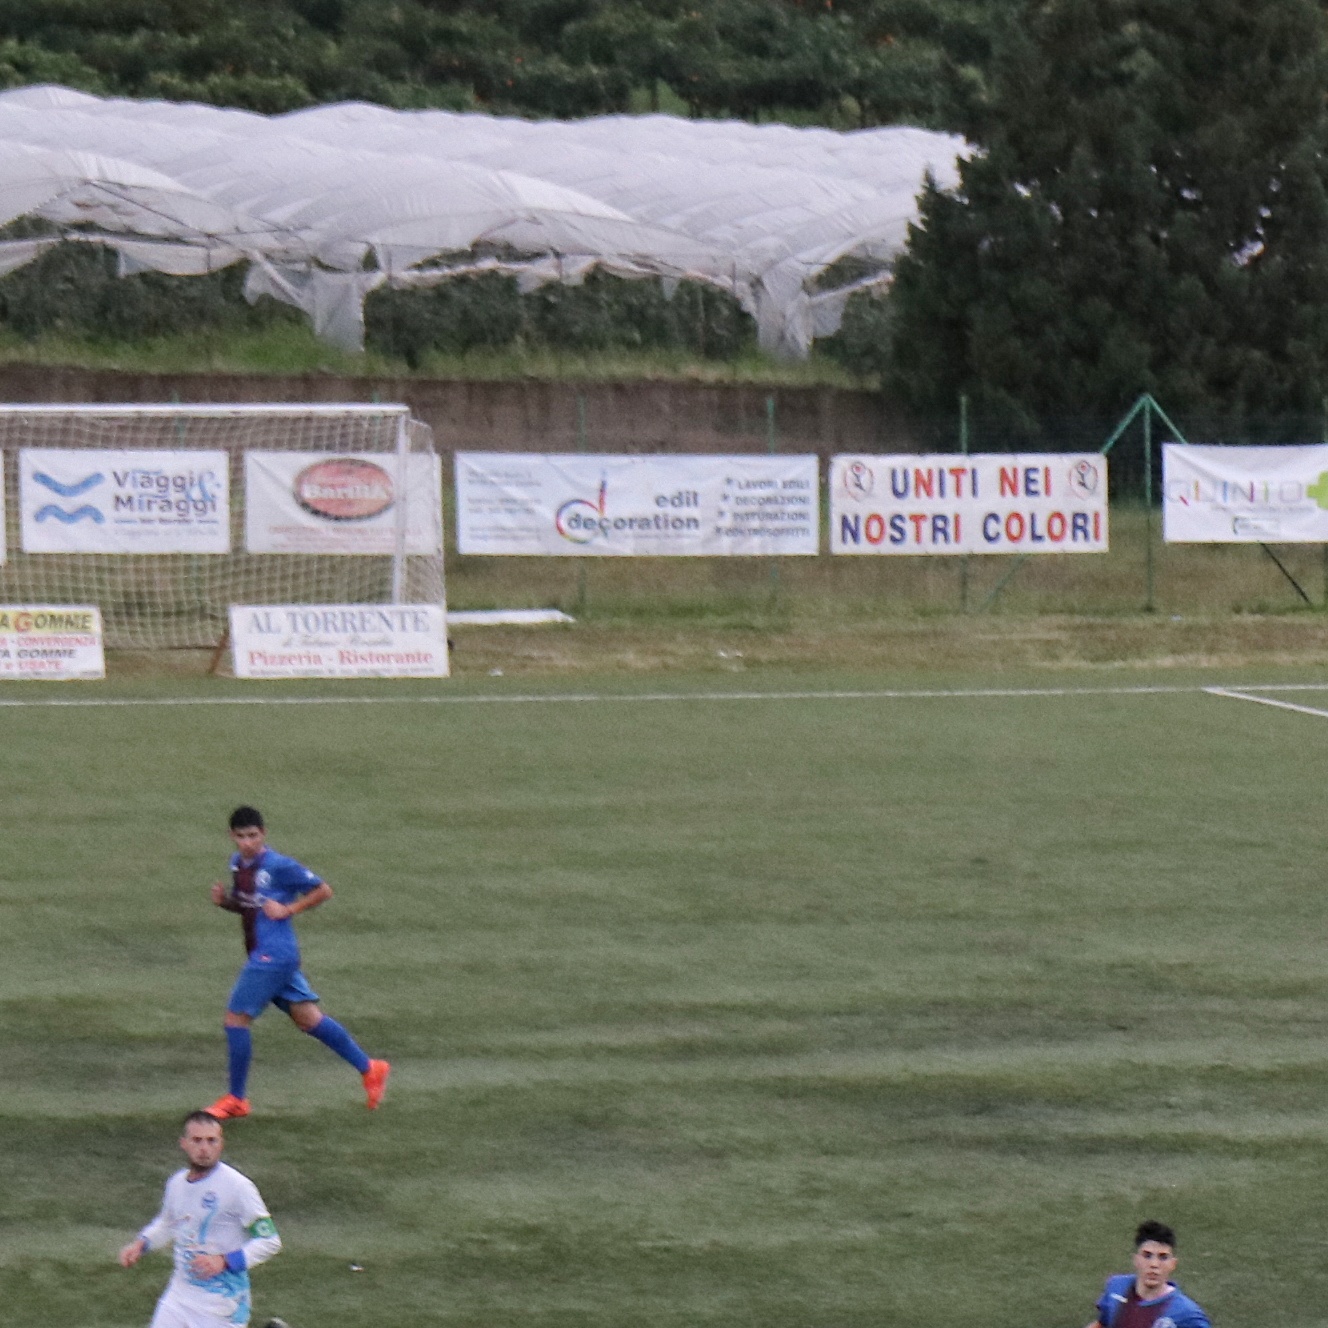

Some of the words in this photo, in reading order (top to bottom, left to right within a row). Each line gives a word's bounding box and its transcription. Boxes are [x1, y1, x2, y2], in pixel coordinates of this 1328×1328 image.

[112, 468, 195, 493] Viaggi
[890, 466, 978, 499] UNITI
[998, 466, 1052, 498] NEI
[113, 494, 217, 517] Miraggi
[654, 490, 699, 508] edil
[566, 512, 700, 532] decoration
[840, 512, 962, 545] NOSTRI
[982, 511, 1101, 544] COLORI
[14, 611, 92, 632] GOMME
[248, 610, 281, 634] AL
[286, 609, 431, 634] TORRENTE
[17, 649, 76, 659] GOMME
[248, 650, 323, 666] Pizzeria
[337, 649, 433, 666] Ristorante
